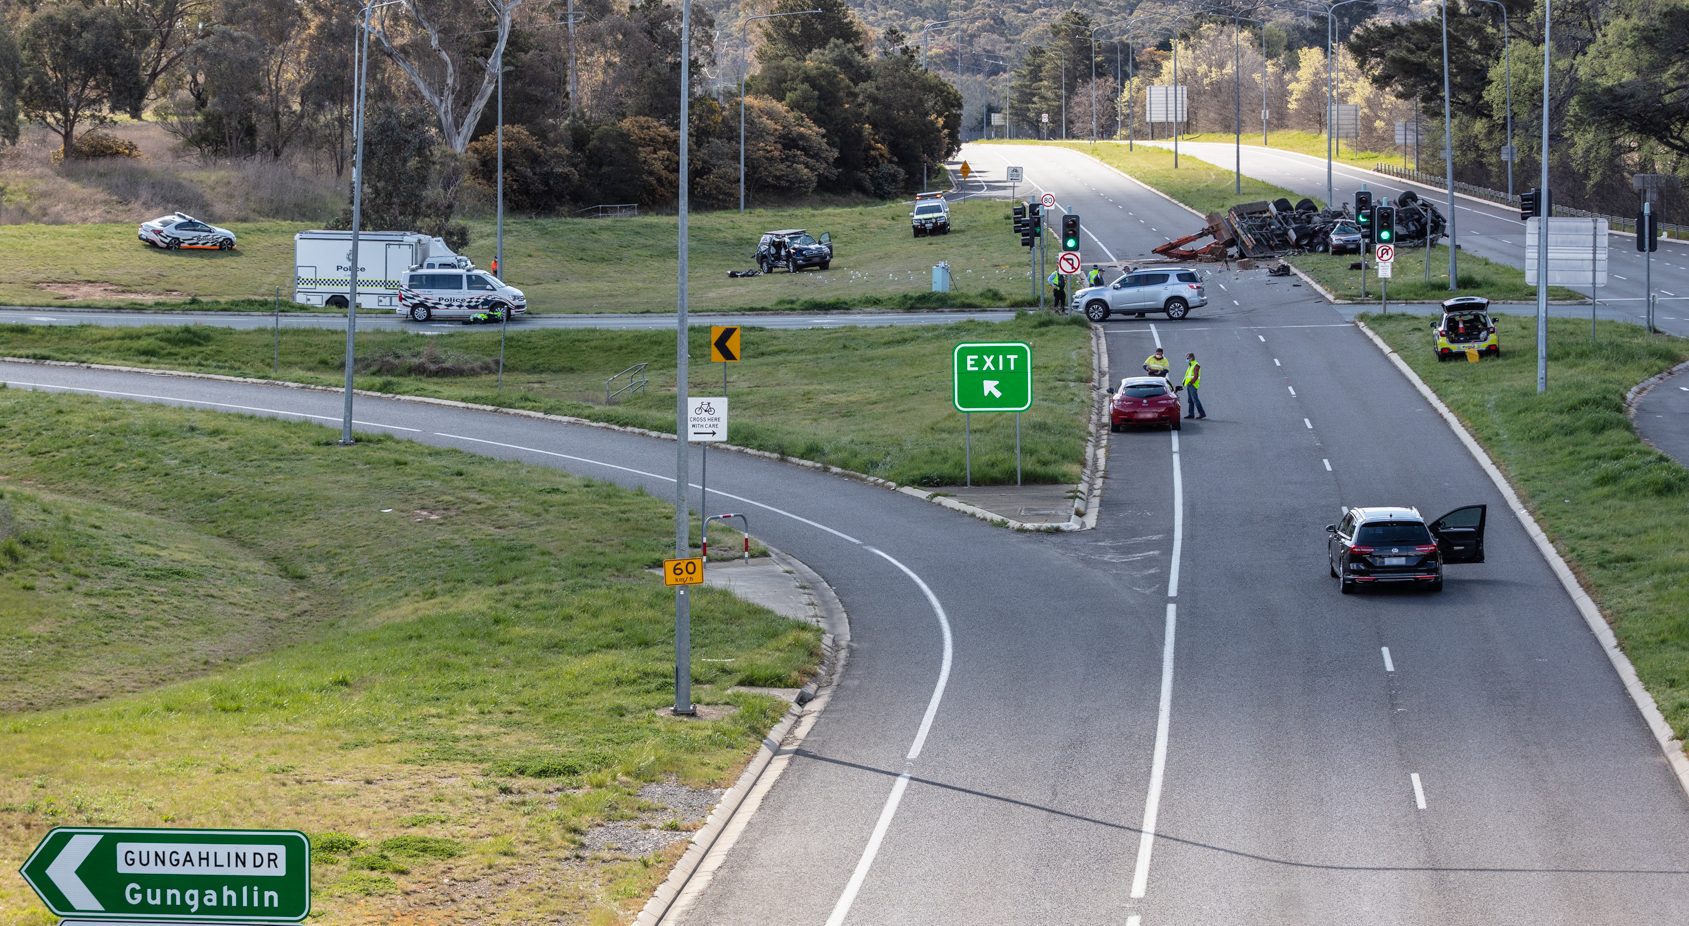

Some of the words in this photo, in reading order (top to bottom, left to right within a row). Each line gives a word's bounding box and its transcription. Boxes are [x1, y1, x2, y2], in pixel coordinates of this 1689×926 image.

[966, 354, 1019, 371] EXIT
[673, 561, 696, 575] 60
[124, 850, 246, 868] GUNGAHLIN
[252, 852, 279, 868] DR
[124, 882, 279, 913] Gungahlin
